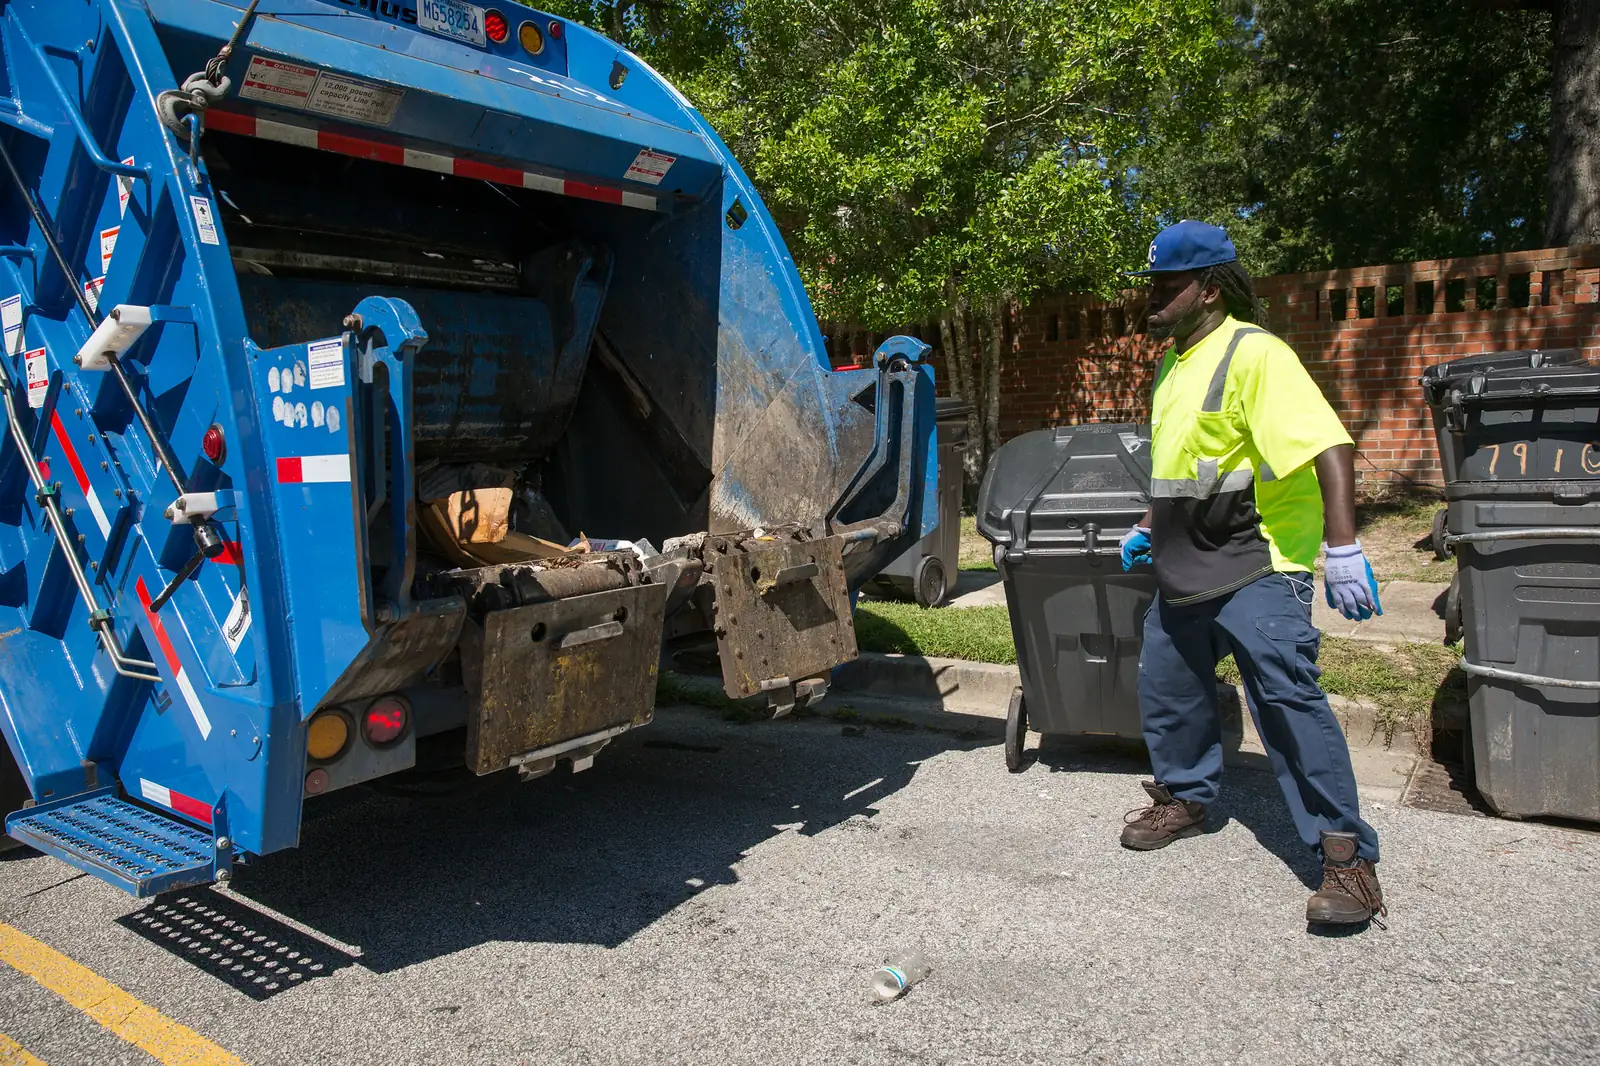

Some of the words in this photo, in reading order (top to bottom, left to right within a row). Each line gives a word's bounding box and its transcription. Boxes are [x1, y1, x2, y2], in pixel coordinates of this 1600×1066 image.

[423, 0, 478, 34] MG58254
[273, 63, 305, 74] DANGER
[265, 85, 295, 95] PELIGRO
[320, 89, 350, 101] capacity
[353, 96, 369, 105] Line
[324, 81, 348, 92] 12,000
[349, 88, 373, 98] pound
